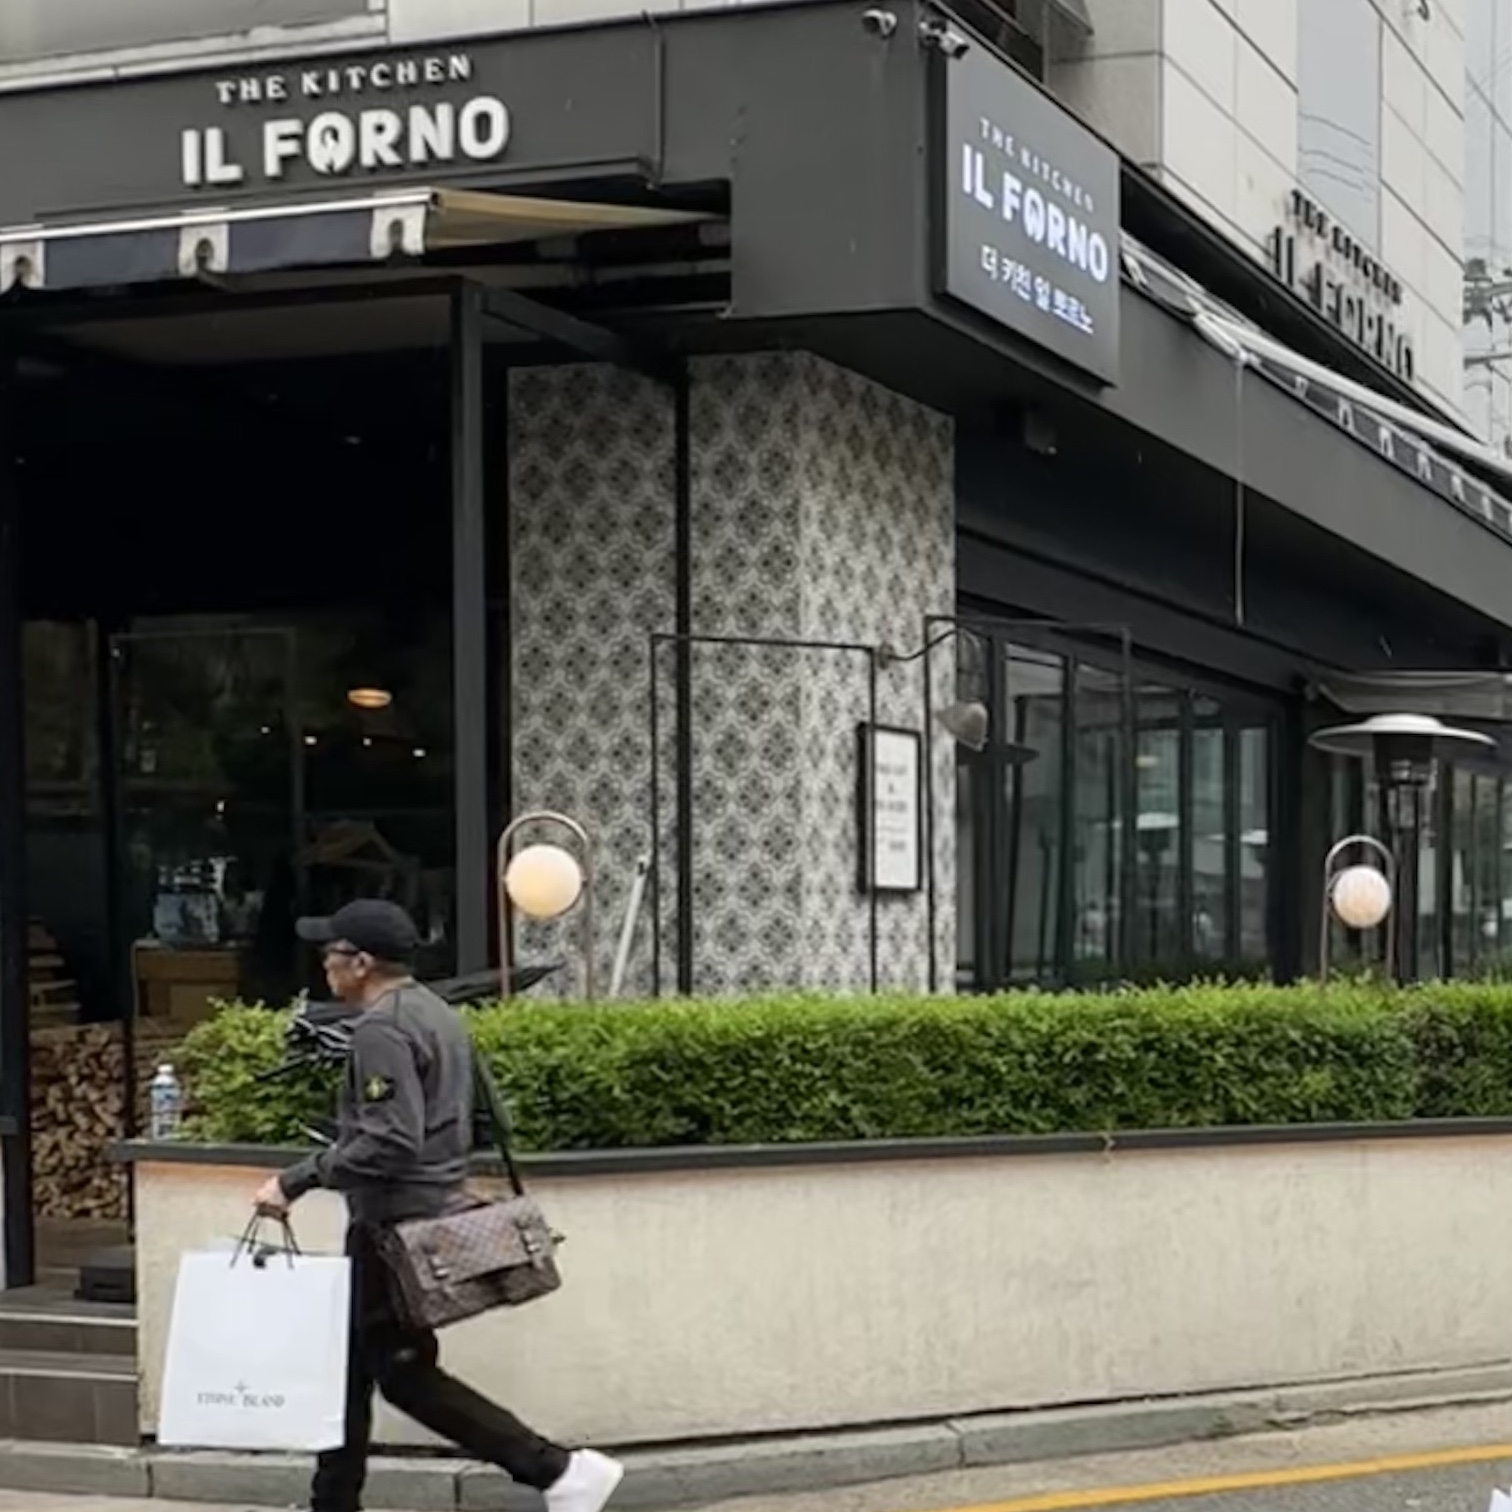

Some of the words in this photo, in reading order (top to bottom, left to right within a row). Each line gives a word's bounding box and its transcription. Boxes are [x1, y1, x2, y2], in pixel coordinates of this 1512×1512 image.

[216, 74, 288, 103] THE
[301, 54, 473, 97] KITCHEN
[181, 126, 244, 186] IL
[263, 96, 509, 178] FORNO
[980, 116, 1015, 156] THE
[1020, 147, 1094, 213] KITCHEN
[962, 143, 994, 209] IL
[1002, 171, 1109, 283] FORNO
[980, 244, 998, 281] 더
